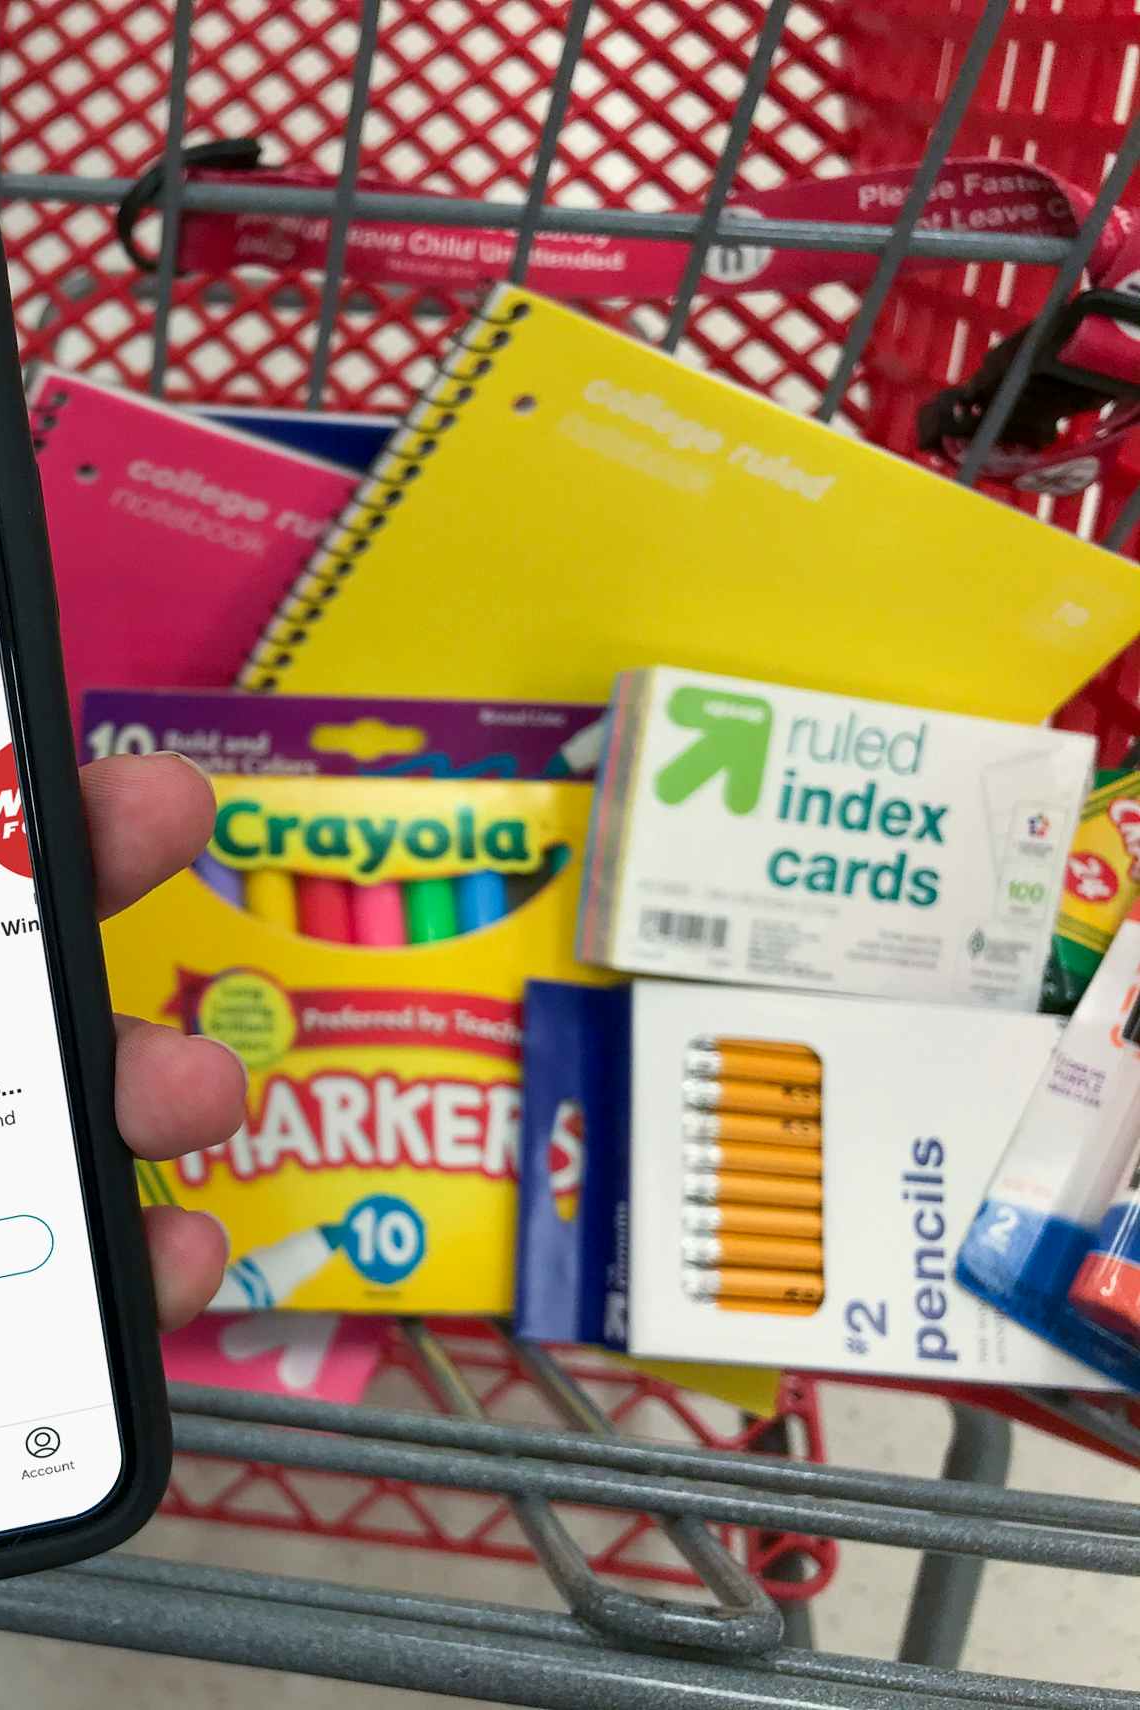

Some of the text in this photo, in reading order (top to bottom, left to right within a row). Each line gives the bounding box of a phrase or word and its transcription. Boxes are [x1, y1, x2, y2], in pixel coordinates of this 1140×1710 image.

[786, 713, 926, 776] ruled
[214, 800, 531, 874] Crayola
[778, 770, 949, 845] index
[768, 848, 940, 909] cards
[1009, 880, 1045, 902] 100
[418, 1004, 448, 1036] by
[351, 1206, 418, 1267] 10
[903, 1137, 958, 1363] pencils
[989, 1204, 1020, 1236] 2
[844, 1300, 887, 1356] #2
[21, 1460, 75, 1480] Account
